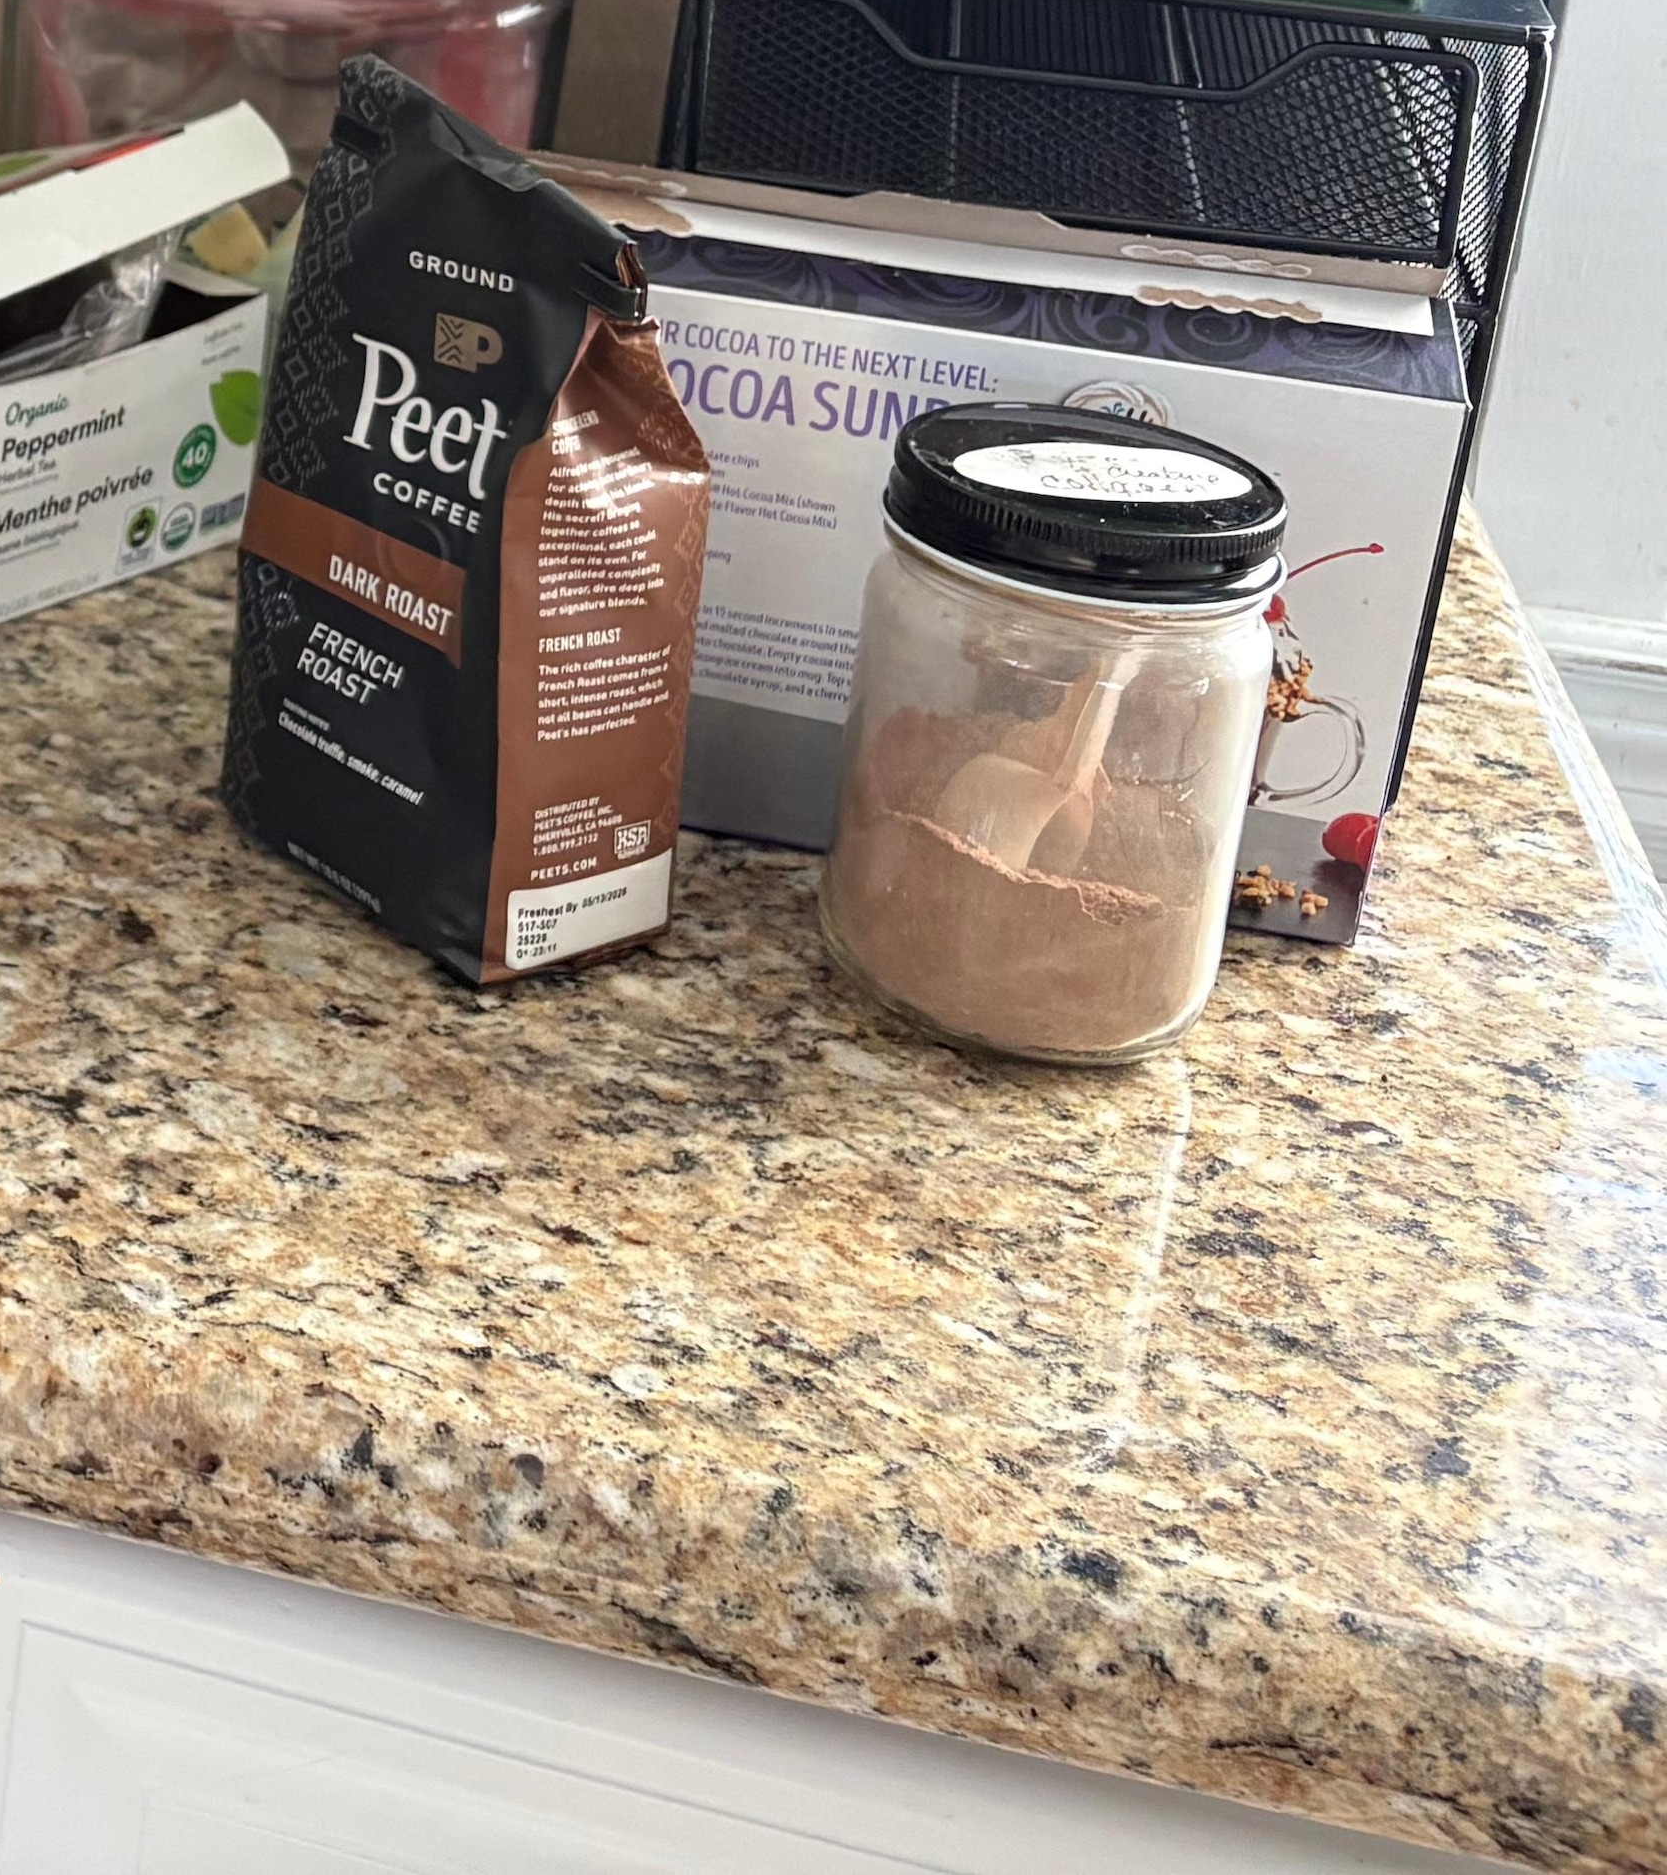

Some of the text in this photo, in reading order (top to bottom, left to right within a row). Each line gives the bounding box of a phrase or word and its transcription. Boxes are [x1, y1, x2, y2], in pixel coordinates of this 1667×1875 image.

[409, 251, 515, 293] GROUND
[685, 325, 760, 357] COCOA
[767, 335, 795, 362] TO
[802, 341, 846, 371] THE
[852, 348, 916, 379] NEXT
[920, 359, 998, 393] LEVEL:
[5, 394, 69, 428] Organic
[1, 406, 125, 462] Peppermint
[182, 441, 205, 466] 40
[732, 455, 760, 469] chips
[75, 466, 154, 513] poivrée
[722, 486, 836, 513] Hot Cocoa Mix (shown
[373, 472, 482, 534] COFFEE
[725, 503, 756, 518] Flavor
[759, 507, 778, 521] Hot
[780, 511, 810, 526] Cocoa
[543, 511, 562, 521] His
[538, 529, 656, 553] exceptional, each could
[541, 525, 590, 538] together
[592, 522, 628, 537] coffees
[538, 550, 646, 567] stand on its own. For
[539, 563, 660, 584] unparalleled complexity
[329, 554, 453, 637] DARK ROAST
[540, 578, 664, 601] and flavor, dive deep into
[539, 597, 647, 617] our signature blends.
[727, 609, 763, 624] second
[765, 614, 823, 634] increments
[539, 628, 621, 653] FRENCH ROAST
[748, 627, 797, 646] chocolate
[308, 621, 404, 689] FRENCH
[539, 645, 671, 676] The rich coffee character of
[767, 647, 801, 664] Empty
[297, 647, 378, 705] ROAST
[538, 663, 668, 692] French Roast comes from a
[538, 679, 663, 708] short, intense roast, which
[538, 691, 669, 724] not all beans can handle and
[537, 715, 636, 741] Peet's has perfected.
[278, 711, 317, 747] Chocolate
[318, 736, 345, 765] truffle,
[347, 754, 380, 783] smoke,
[381, 774, 424, 806] caramel
[534, 805, 613, 831] PEET'S COFFEE, INC.
[535, 797, 600, 820] DISTRIBUTED BY
[533, 826, 584, 844] EMERYVILLE,
[585, 821, 596, 831] CA
[530, 857, 597, 881] PEETS.COM
[518, 906, 563, 919] Freshest
[566, 902, 578, 913] By
